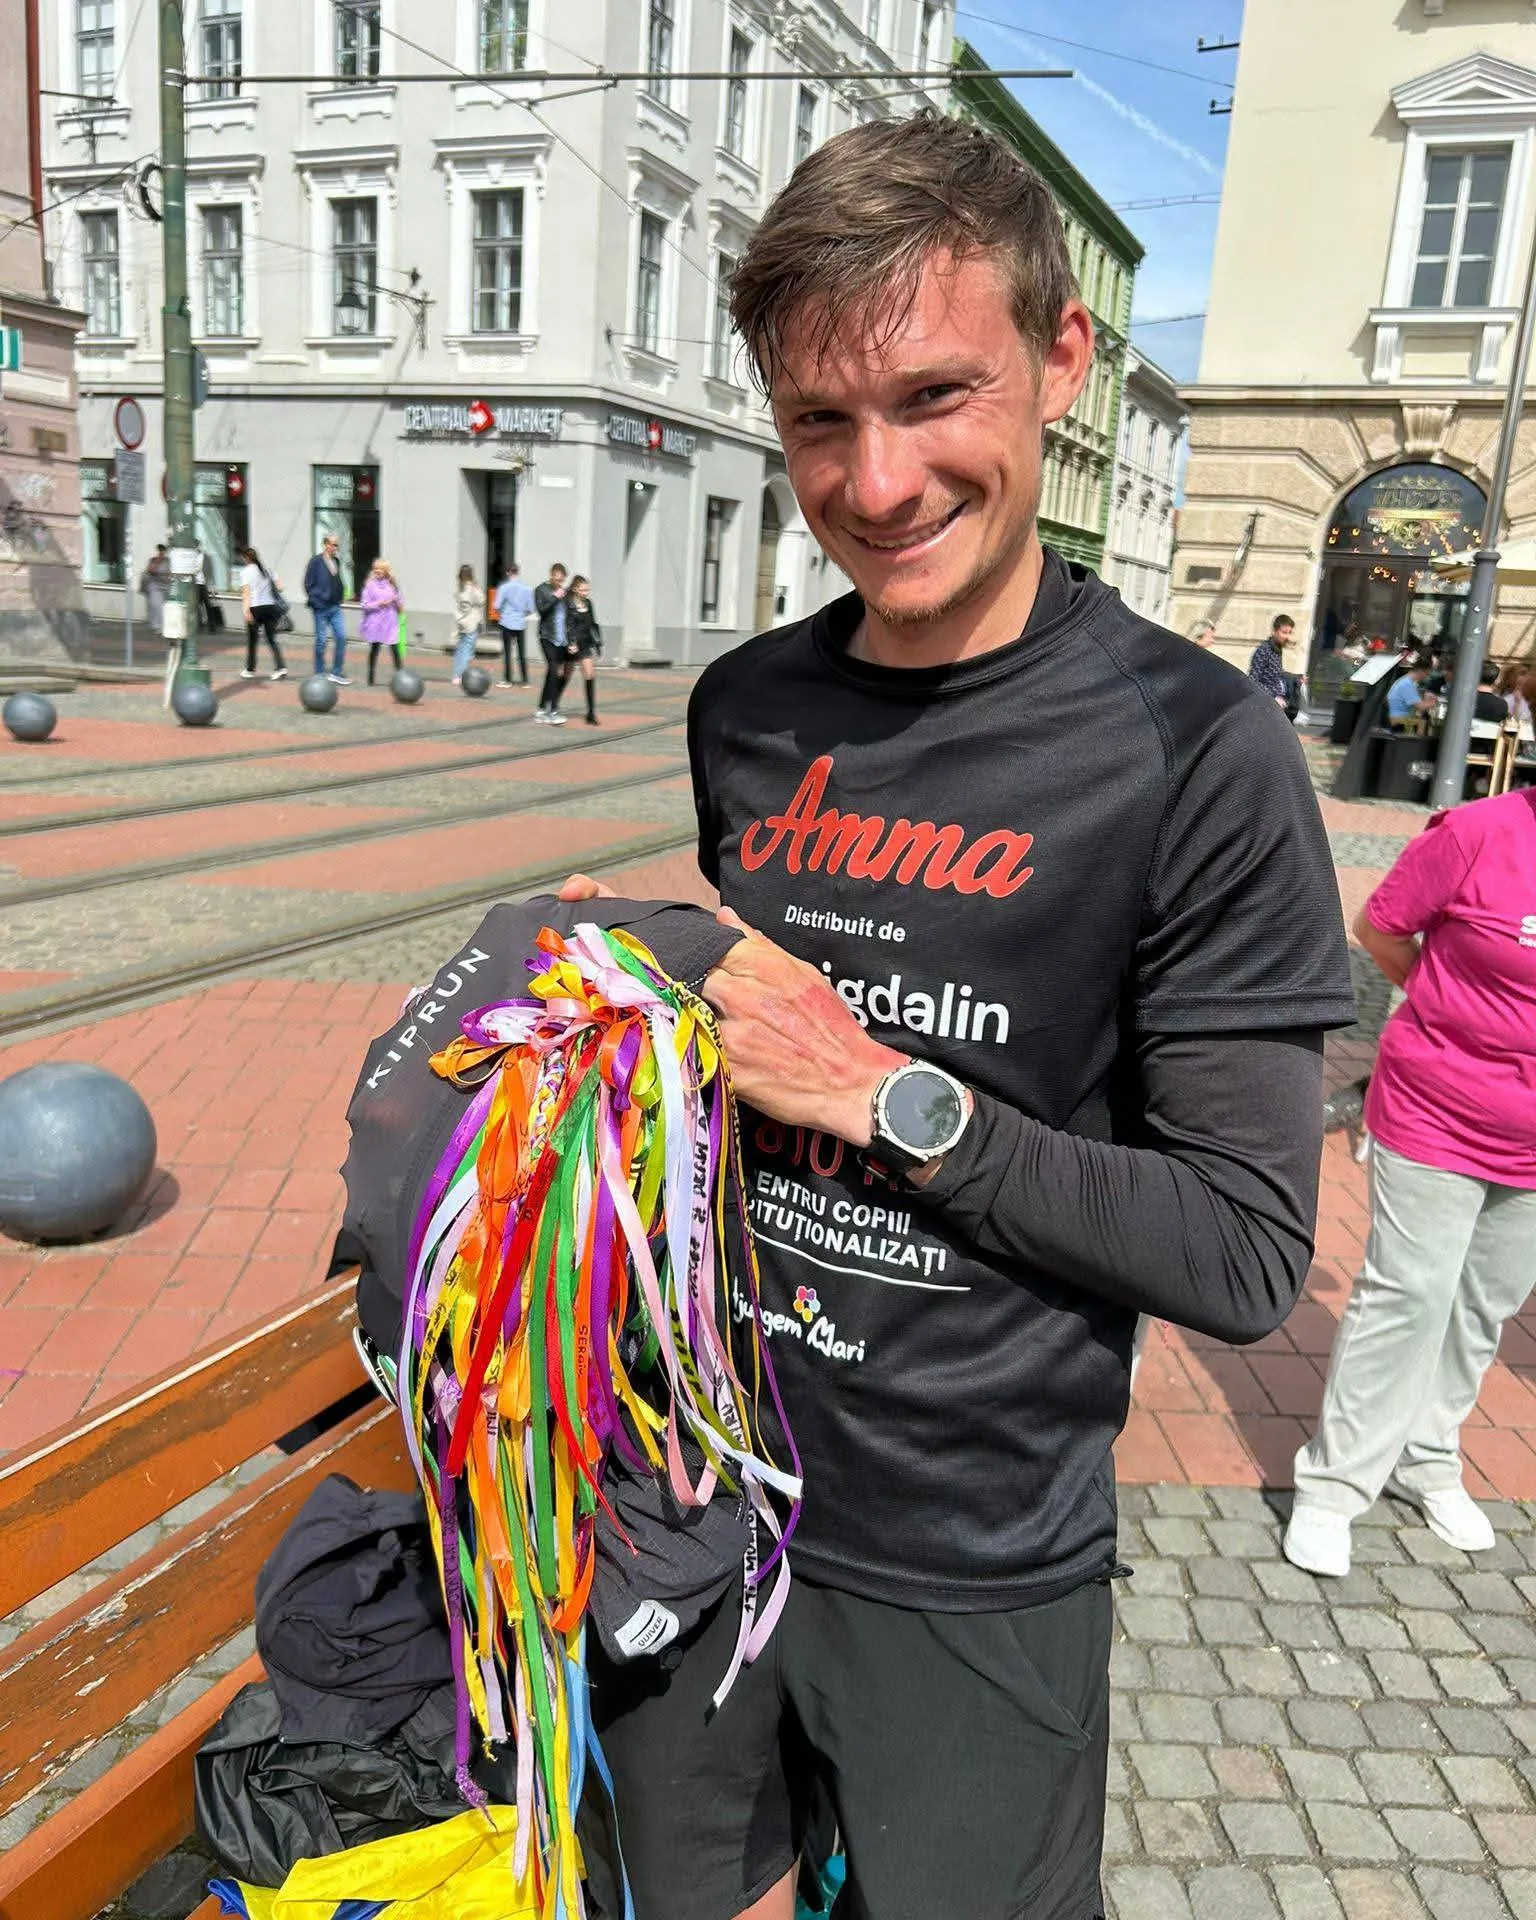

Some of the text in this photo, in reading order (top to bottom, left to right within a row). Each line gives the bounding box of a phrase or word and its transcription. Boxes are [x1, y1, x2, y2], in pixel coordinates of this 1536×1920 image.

[404, 404, 563, 433] CENTRAL MARKET
[609, 415, 697, 457] CENTRAL MARKET
[740, 755, 1034, 898] Amma
[784, 904, 906, 943] Distribuit de
[366, 947, 491, 1089] KIPRUN
[755, 1169, 912, 1236] ENTRU COPIII
[748, 1198, 948, 1278] ITUȚIONALIZAȚI
